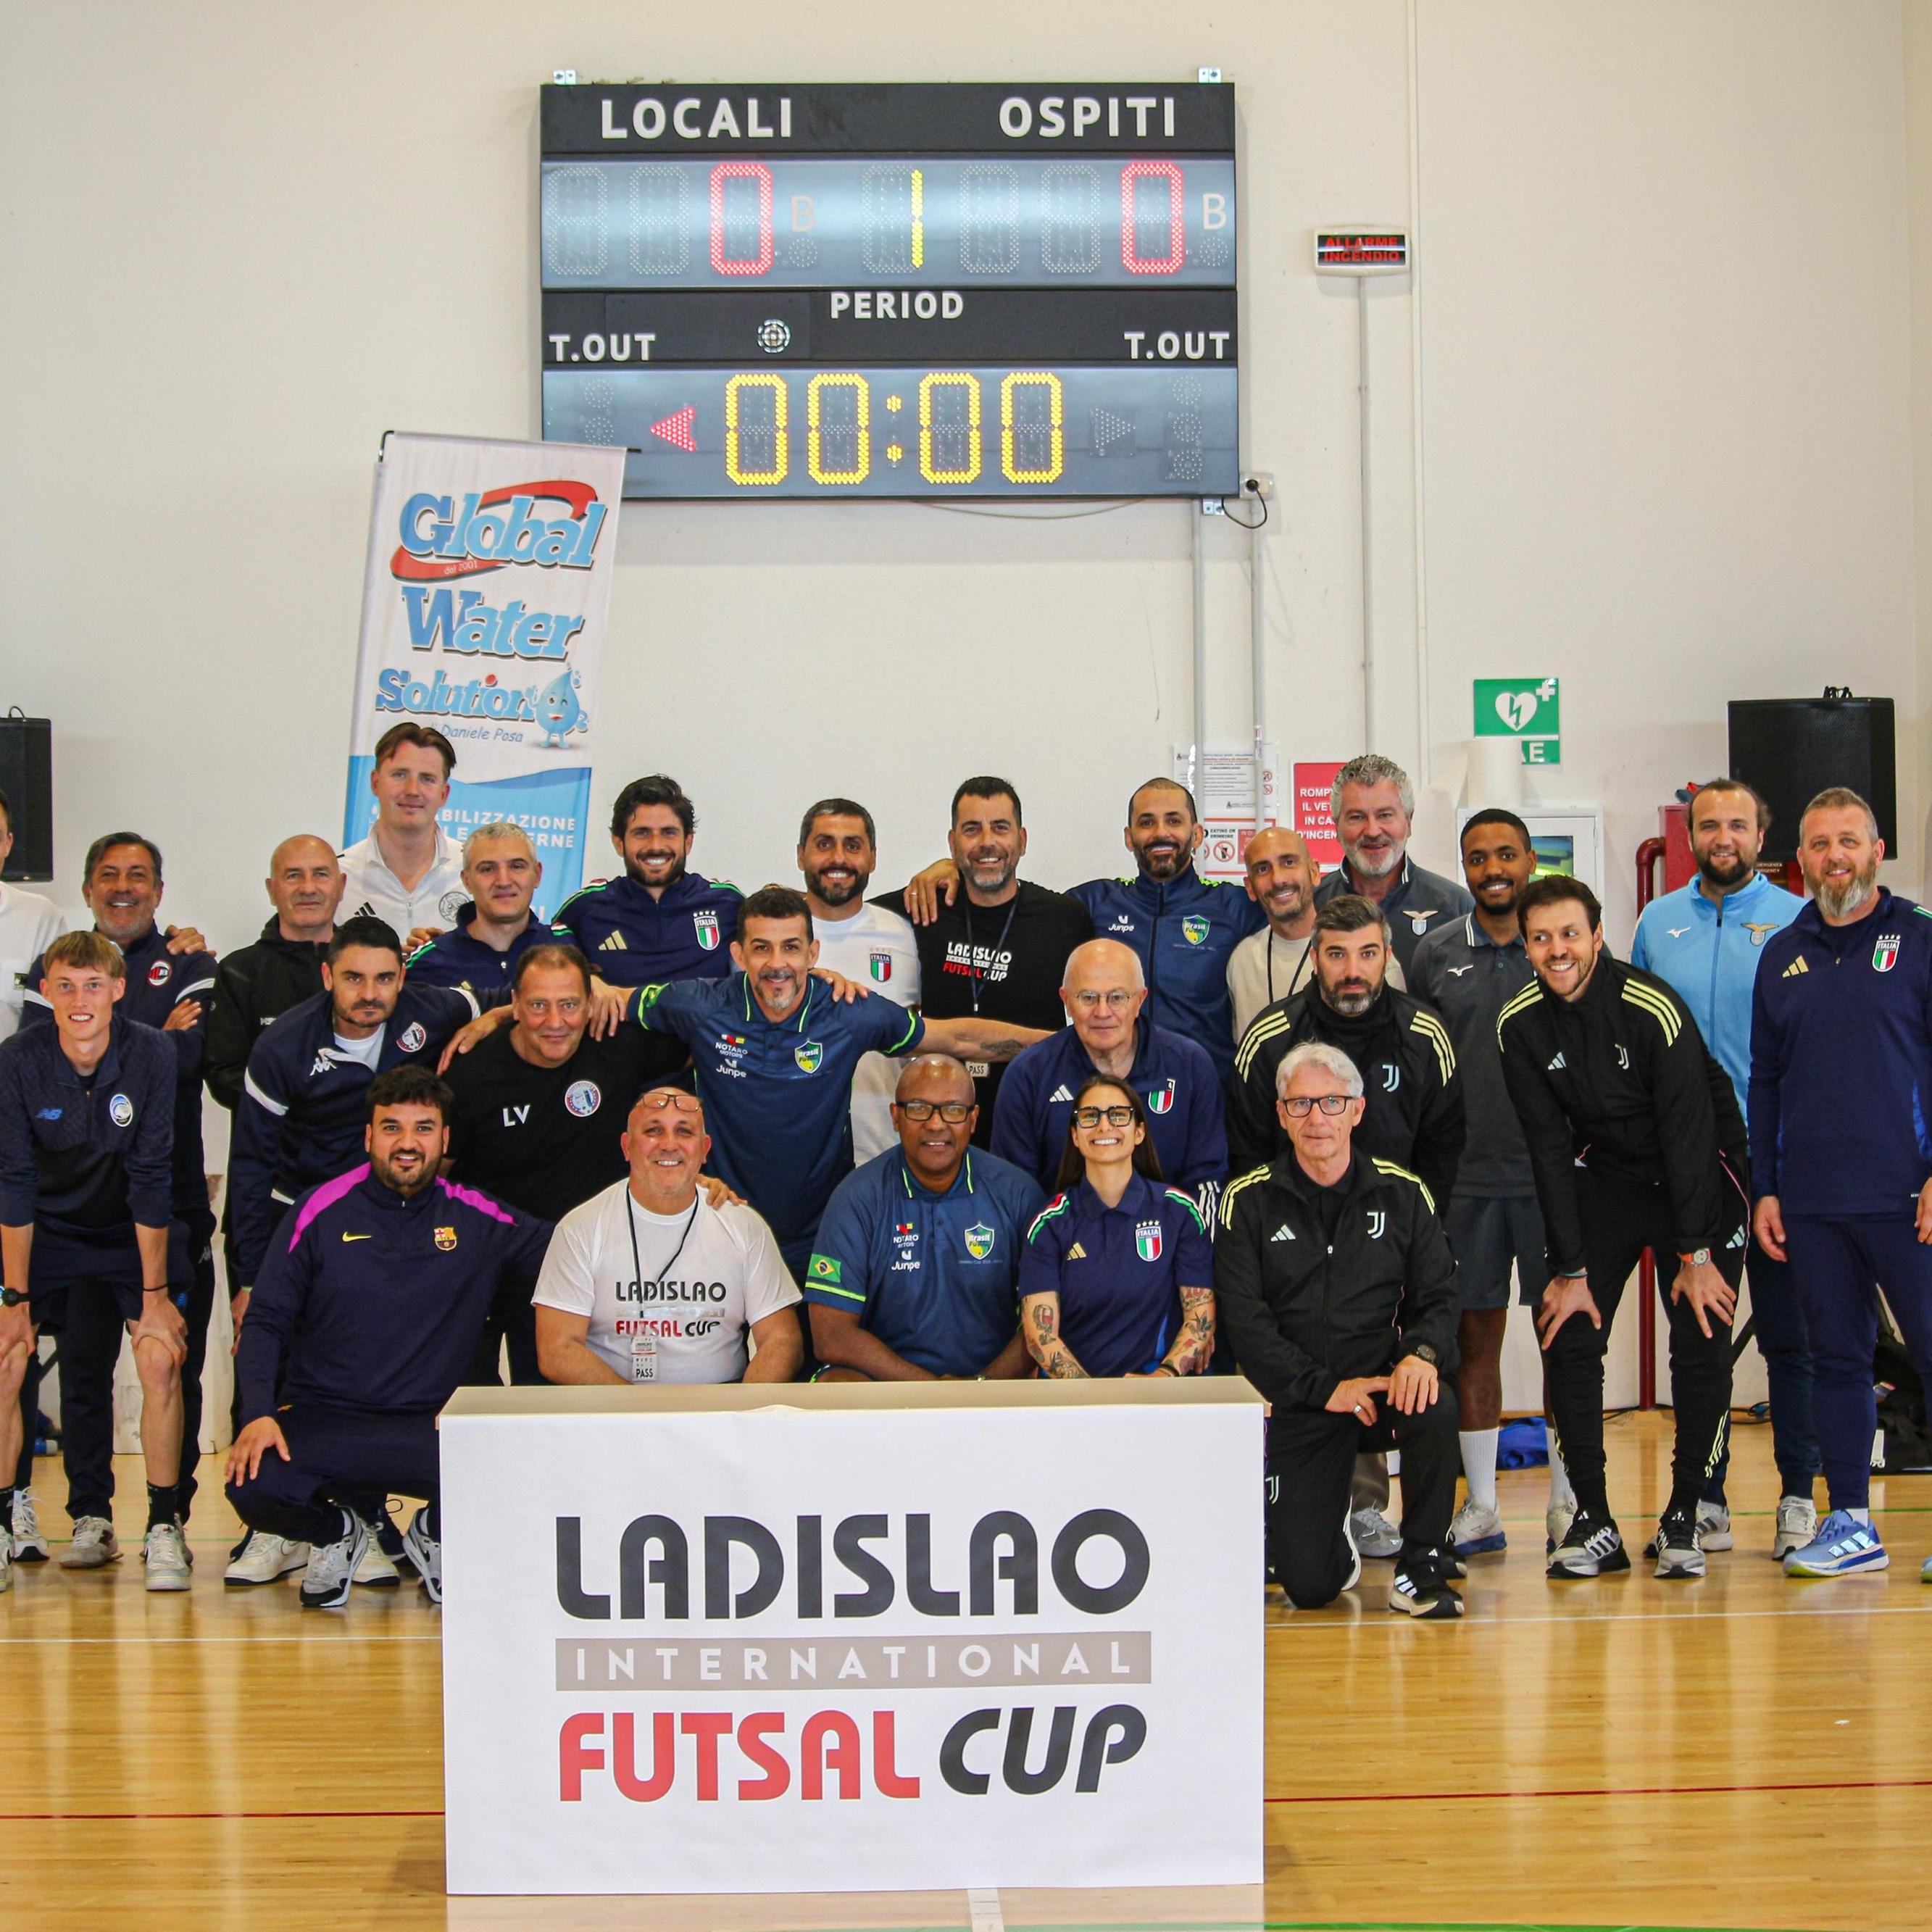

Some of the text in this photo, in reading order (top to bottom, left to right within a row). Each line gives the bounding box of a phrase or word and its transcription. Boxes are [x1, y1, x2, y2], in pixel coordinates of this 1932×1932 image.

[601, 98, 792, 139] LOCALI
[999, 96, 1175, 138] OSPITI
[709, 164, 773, 276] 0
[791, 195, 816, 232] B
[910, 169, 924, 269] 1
[1121, 162, 1183, 274] 0
[1202, 193, 1228, 230] B
[1325, 236, 1398, 248] ALLARME
[1323, 251, 1400, 262] INCENDIO
[830, 292, 964, 320] PERIOD
[549, 333, 656, 362] T.OUT
[1124, 331, 1230, 359] T.OUT
[725, 372, 1064, 486] 00:00
[399, 492, 607, 570] Global
[458, 560, 478, 572] 2001
[401, 586, 586, 662] Water
[375, 667, 536, 723] Solution
[441, 724, 490, 740] Daniele
[1302, 802, 1312, 811] IL
[1304, 816, 1336, 825] IN CA
[696, 918, 716, 927] ITALIA
[1108, 923, 1135, 933] Junpe
[1185, 920, 1206, 930] Brasil
[715, 1042, 748, 1055] NOTARO
[799, 1048, 819, 1057] Brasil
[716, 1065, 747, 1078] Junpe
[969, 1065, 984, 1074] PASS
[502, 1104, 530, 1127] LV
[891, 1261, 921, 1272] Junpe
[616, 1281, 727, 1302] LADISLAO
[616, 1320, 683, 1337] FUTSAL
[636, 1367, 654, 1378] PASS
[555, 1508, 1151, 1620] LADISLAO
[575, 1640, 1131, 1682] INTERNATIONAL
[559, 1703, 1148, 1803] FUTSAL CUP
